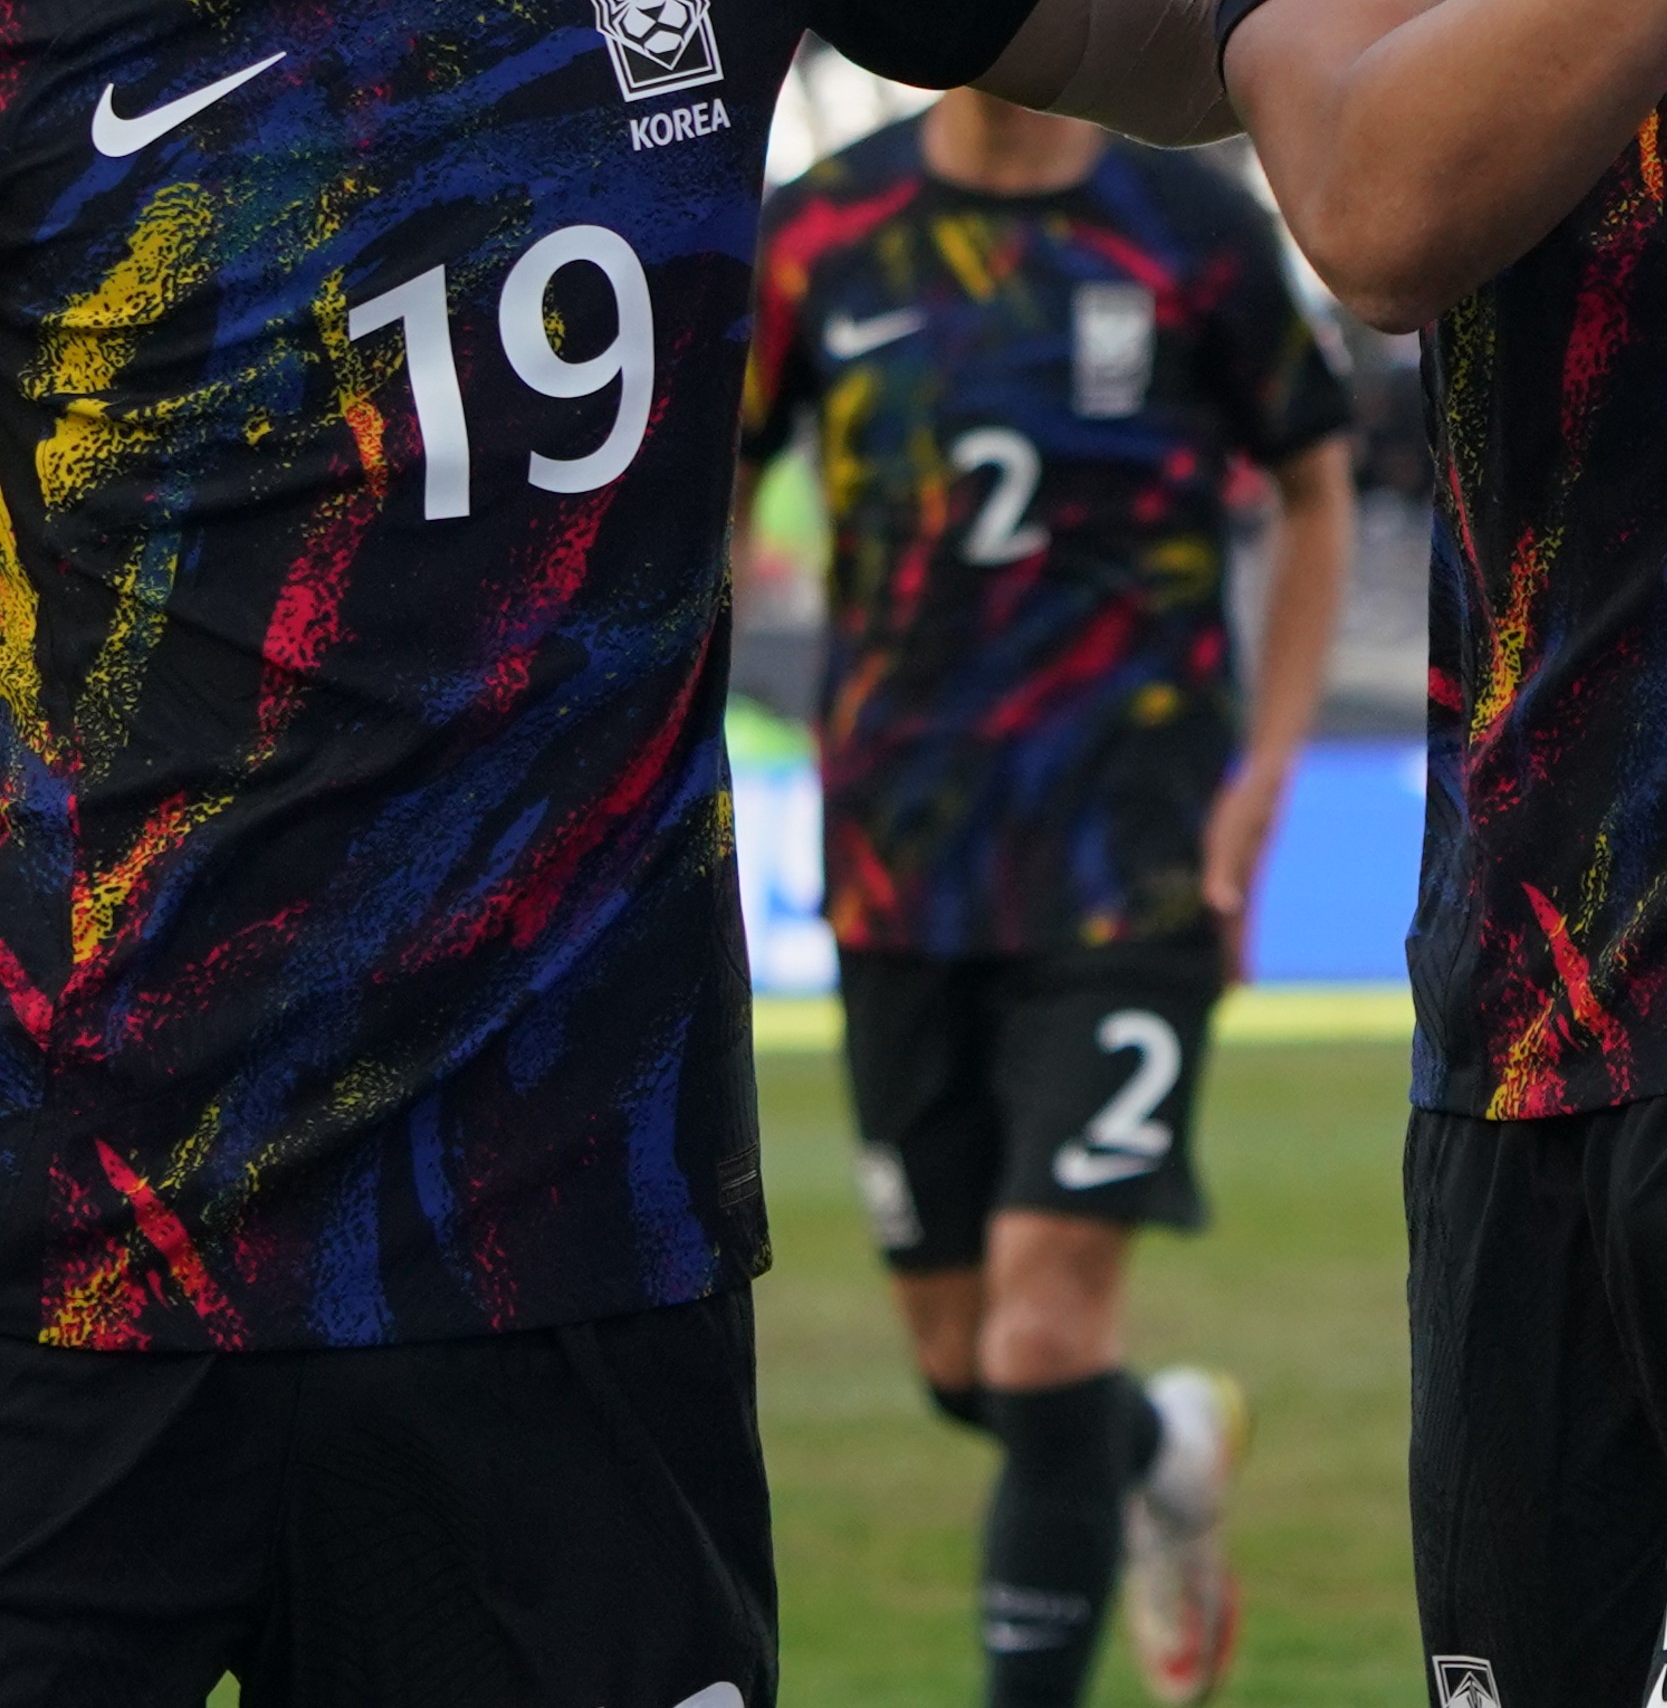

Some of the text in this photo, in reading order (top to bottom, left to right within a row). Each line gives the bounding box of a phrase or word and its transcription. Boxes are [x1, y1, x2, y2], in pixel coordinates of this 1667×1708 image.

[629, 98, 732, 151] KOREA
[348, 224, 656, 521] 19
[950, 427, 1052, 566] 2
[1096, 1008, 1182, 1150] 2
